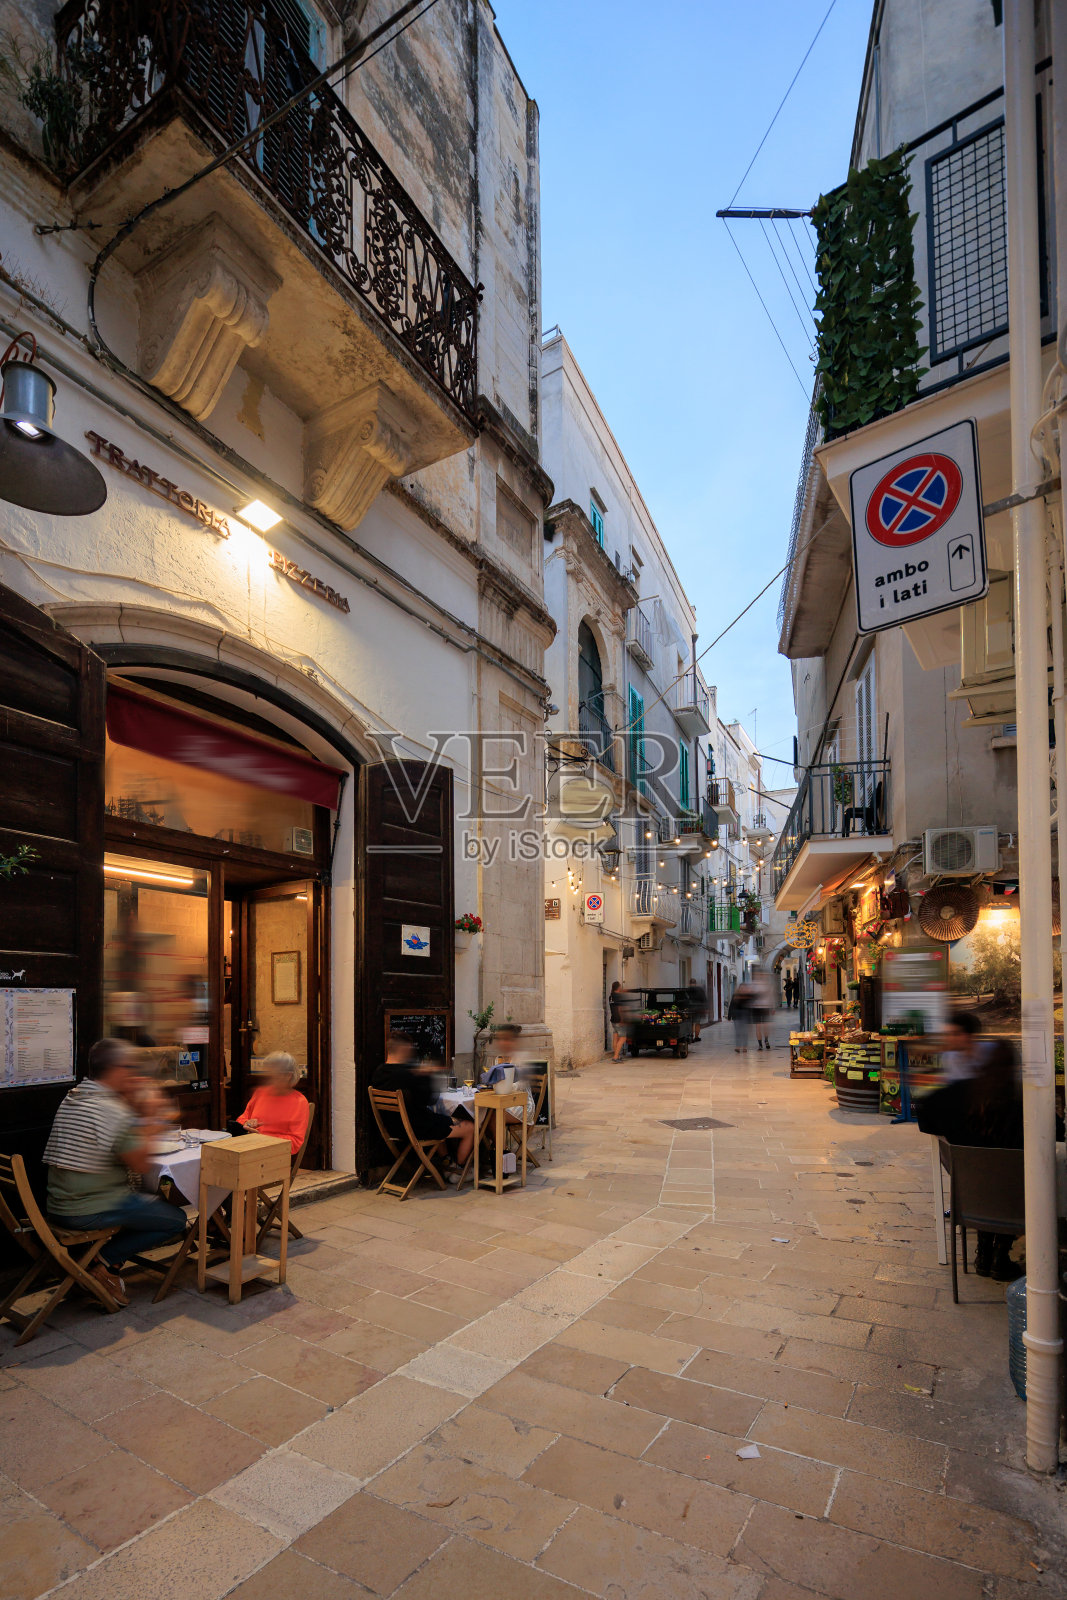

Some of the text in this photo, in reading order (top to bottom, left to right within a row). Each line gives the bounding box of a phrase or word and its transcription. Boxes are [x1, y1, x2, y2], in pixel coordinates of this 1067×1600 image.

[84, 430, 350, 614] TRATTORIA PIZZERIA
[874, 560, 929, 587] ambo
[879, 580, 928, 609] i lati
